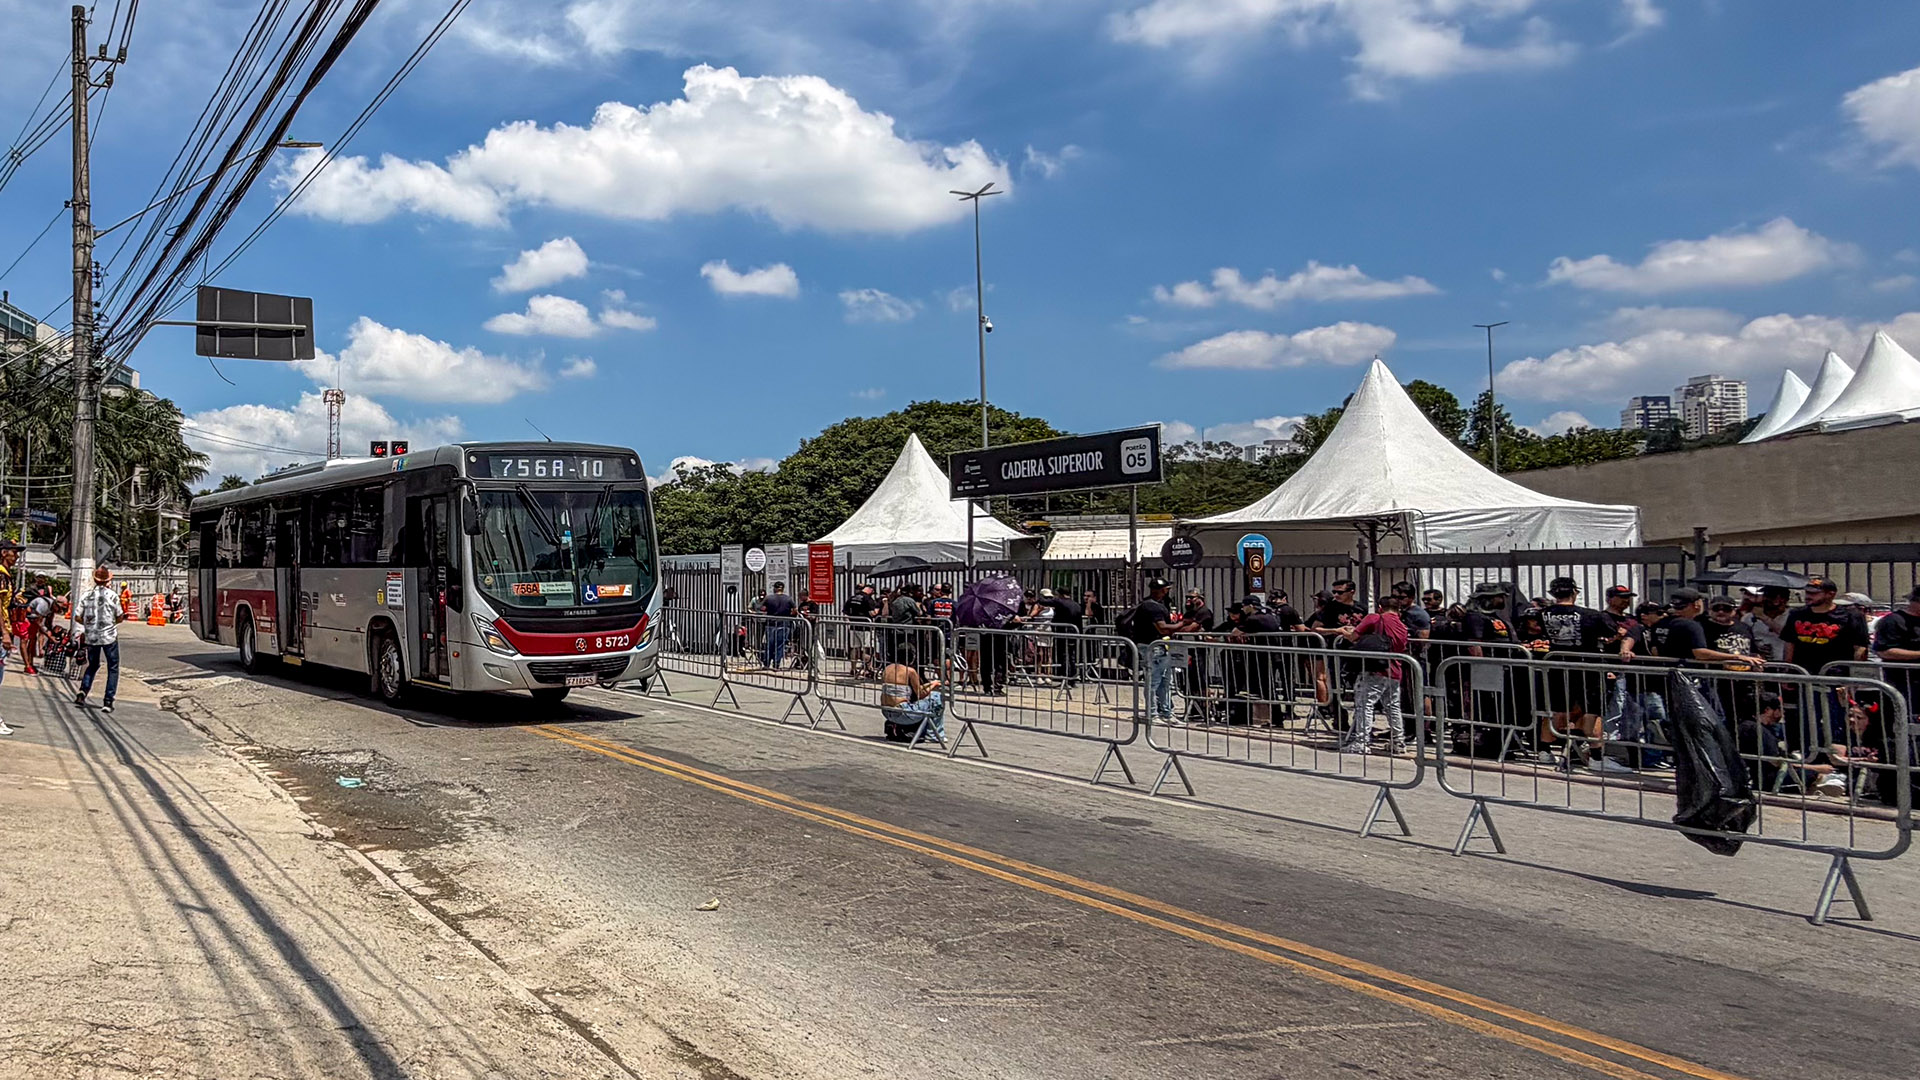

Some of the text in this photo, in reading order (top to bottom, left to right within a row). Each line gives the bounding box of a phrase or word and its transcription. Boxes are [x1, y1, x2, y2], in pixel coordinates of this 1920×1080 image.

[1001, 459, 1045, 480] CADEIRA
[1048, 451, 1104, 475] SUPERIOR
[1126, 453, 1147, 468] 05
[515, 584, 539, 594] 756A
[595, 637, 603, 648] 8
